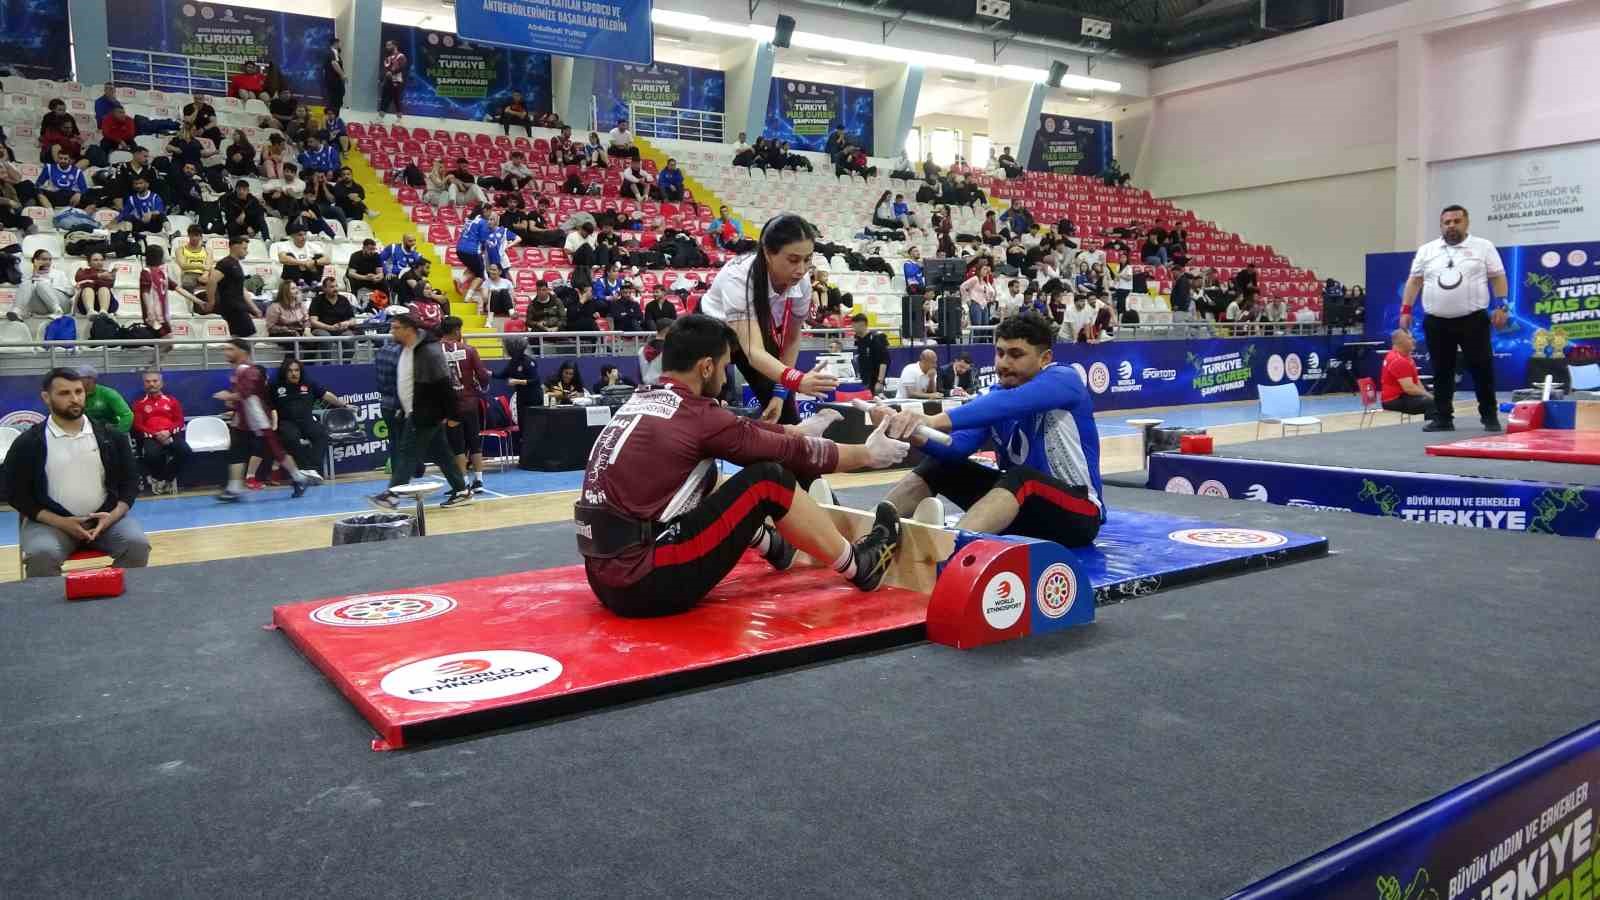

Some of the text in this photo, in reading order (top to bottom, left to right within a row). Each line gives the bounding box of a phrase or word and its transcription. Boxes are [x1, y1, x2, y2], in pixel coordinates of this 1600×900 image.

[195, 34, 254, 44] TÜRKİYE
[438, 60, 486, 69] TÜRKİYE
[1490, 184, 1583, 202] TÜM ANTRENÖR VE
[1534, 298, 1580, 314] MAS
[1202, 358, 1242, 375] TÜRKİYE
[1406, 495, 1521, 507] BÜYÜK KADIN VE ERKEKLER
[408, 666, 550, 695] ETHNOSPORT
[436, 667, 515, 684] WORLD
[1448, 855, 1488, 900] BÜYÜK
[1489, 828, 1523, 872] KADIN
[1525, 819, 1540, 844] VE
[1540, 781, 1589, 833] ERKEKLER
